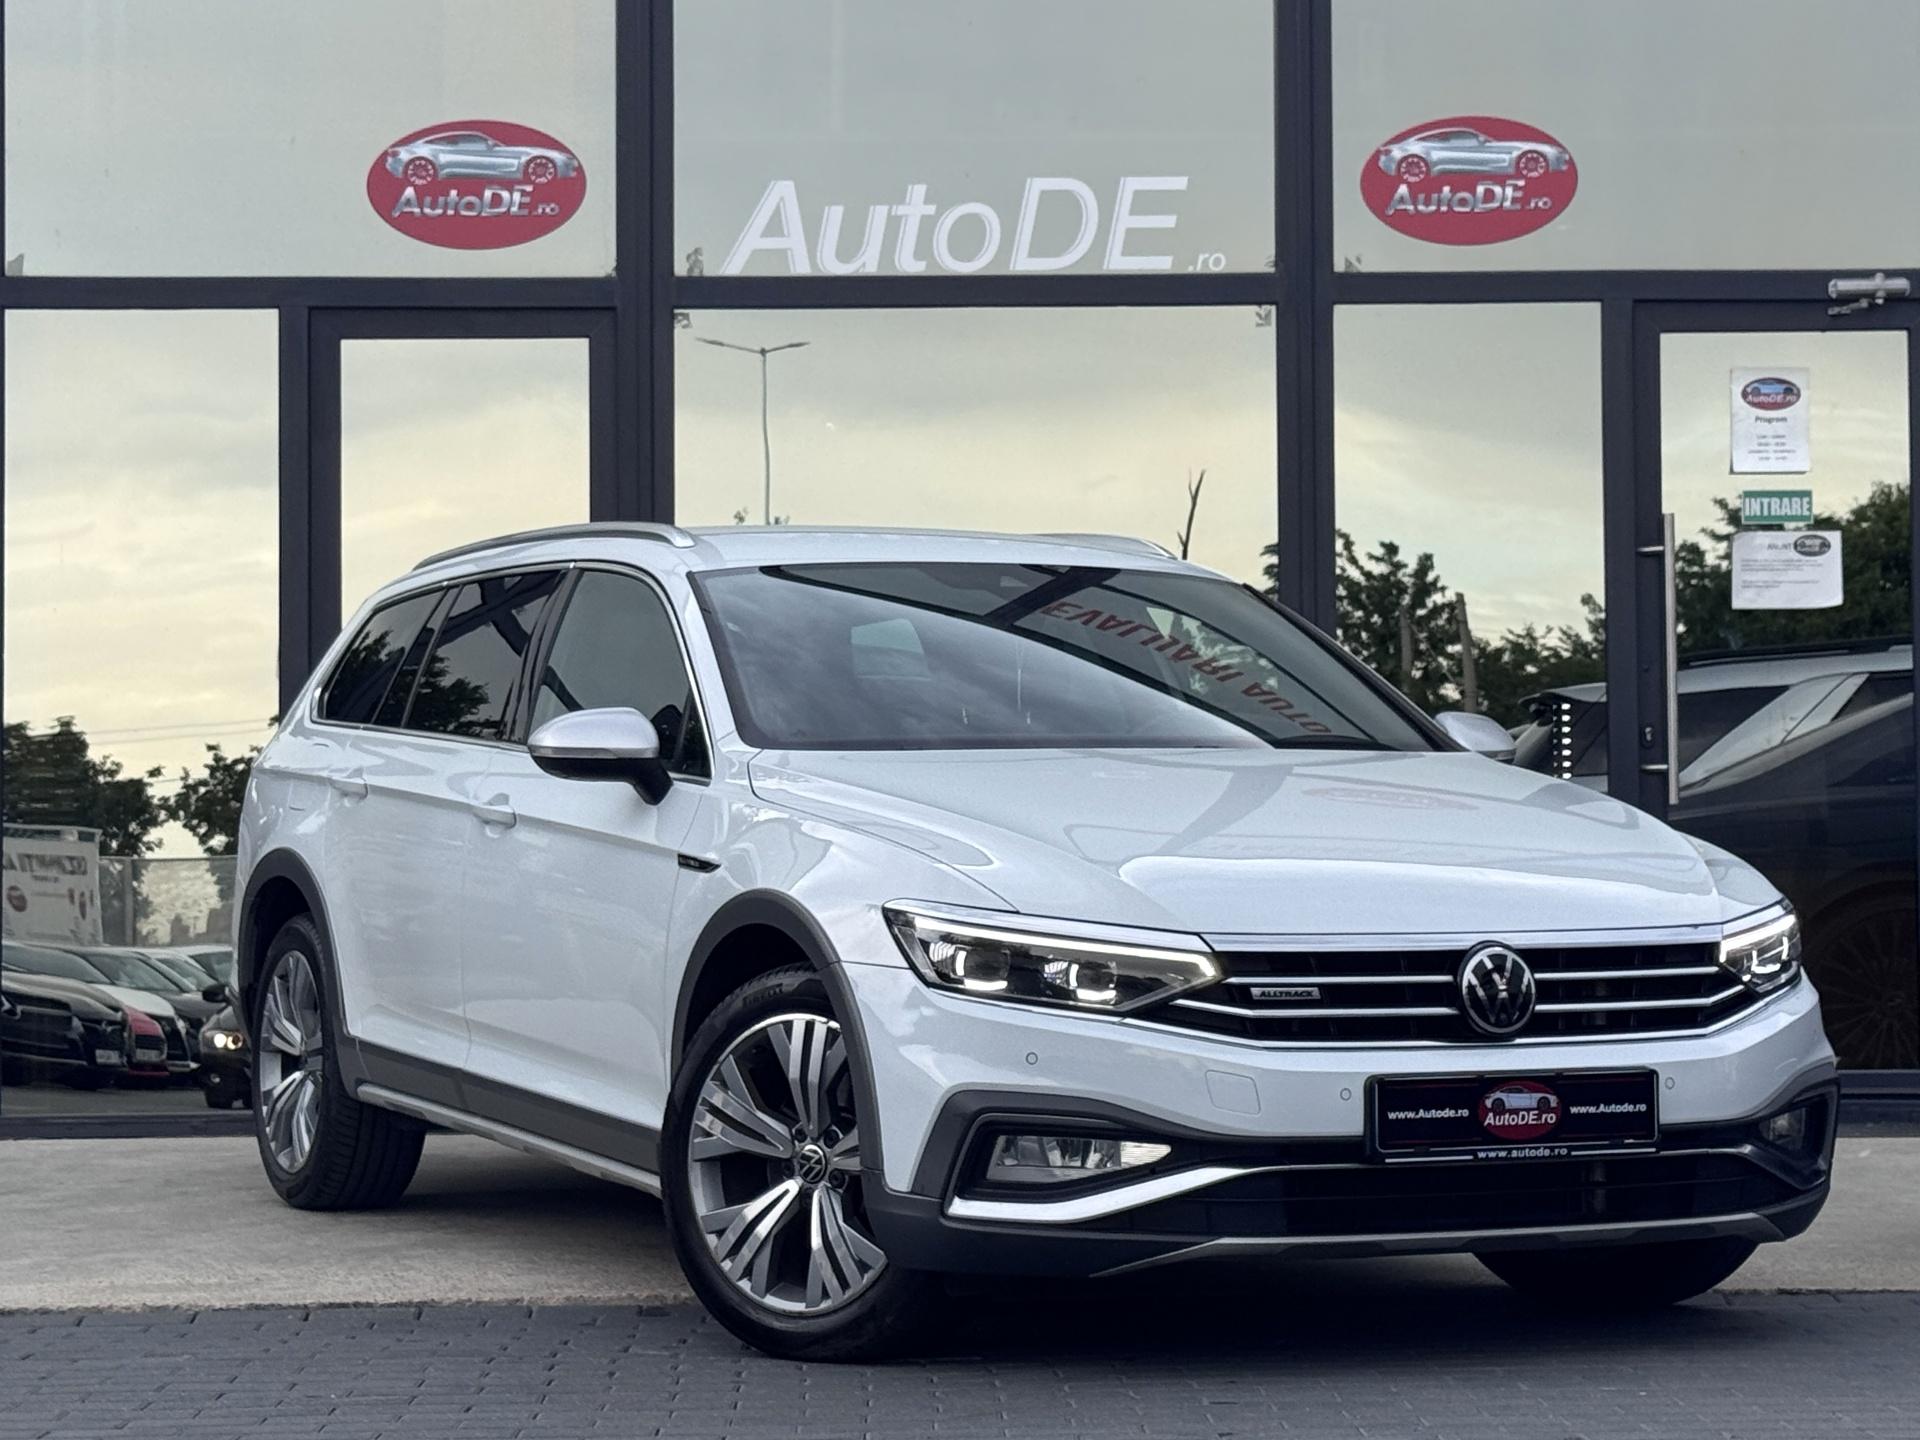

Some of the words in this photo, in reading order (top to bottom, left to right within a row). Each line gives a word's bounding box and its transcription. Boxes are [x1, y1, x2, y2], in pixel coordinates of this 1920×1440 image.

[1744, 497, 1811, 517] INTRARE
[1258, 989, 1315, 998] ALLTRACK
[1387, 1108, 1469, 1120] www.Autode.ro
[1569, 1102, 1647, 1115] www.Autode.ro
[1484, 1110, 1557, 1127] AutoDE.ro
[1477, 1147, 1568, 1159] www.autode.ro
